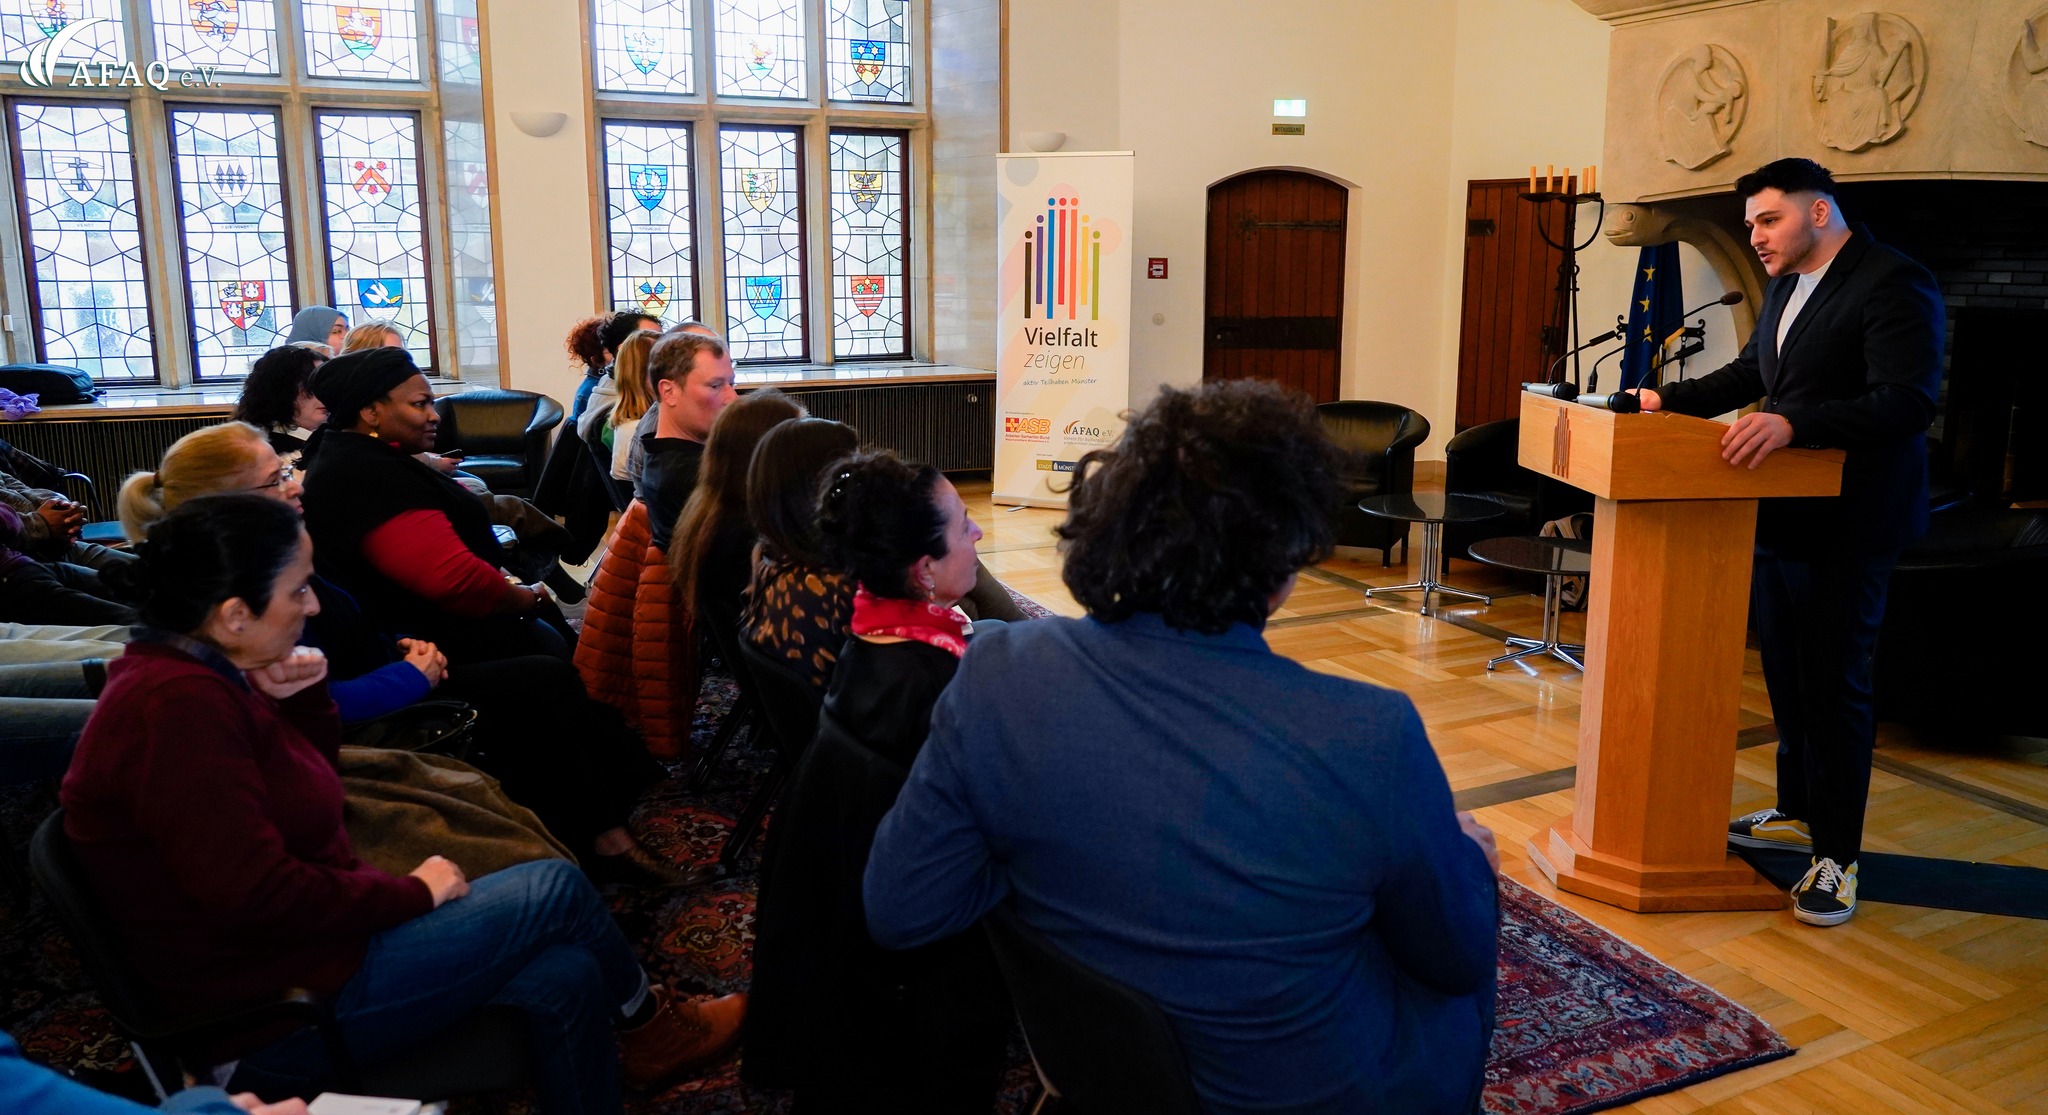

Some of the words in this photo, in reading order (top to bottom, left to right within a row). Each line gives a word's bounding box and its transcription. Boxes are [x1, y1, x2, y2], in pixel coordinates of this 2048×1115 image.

[1024, 326, 1098, 348] Vielfalt
[1023, 350, 1085, 375] zeigen
[1017, 417, 1051, 435] ASB
[1071, 426, 1100, 438] AFAQ
